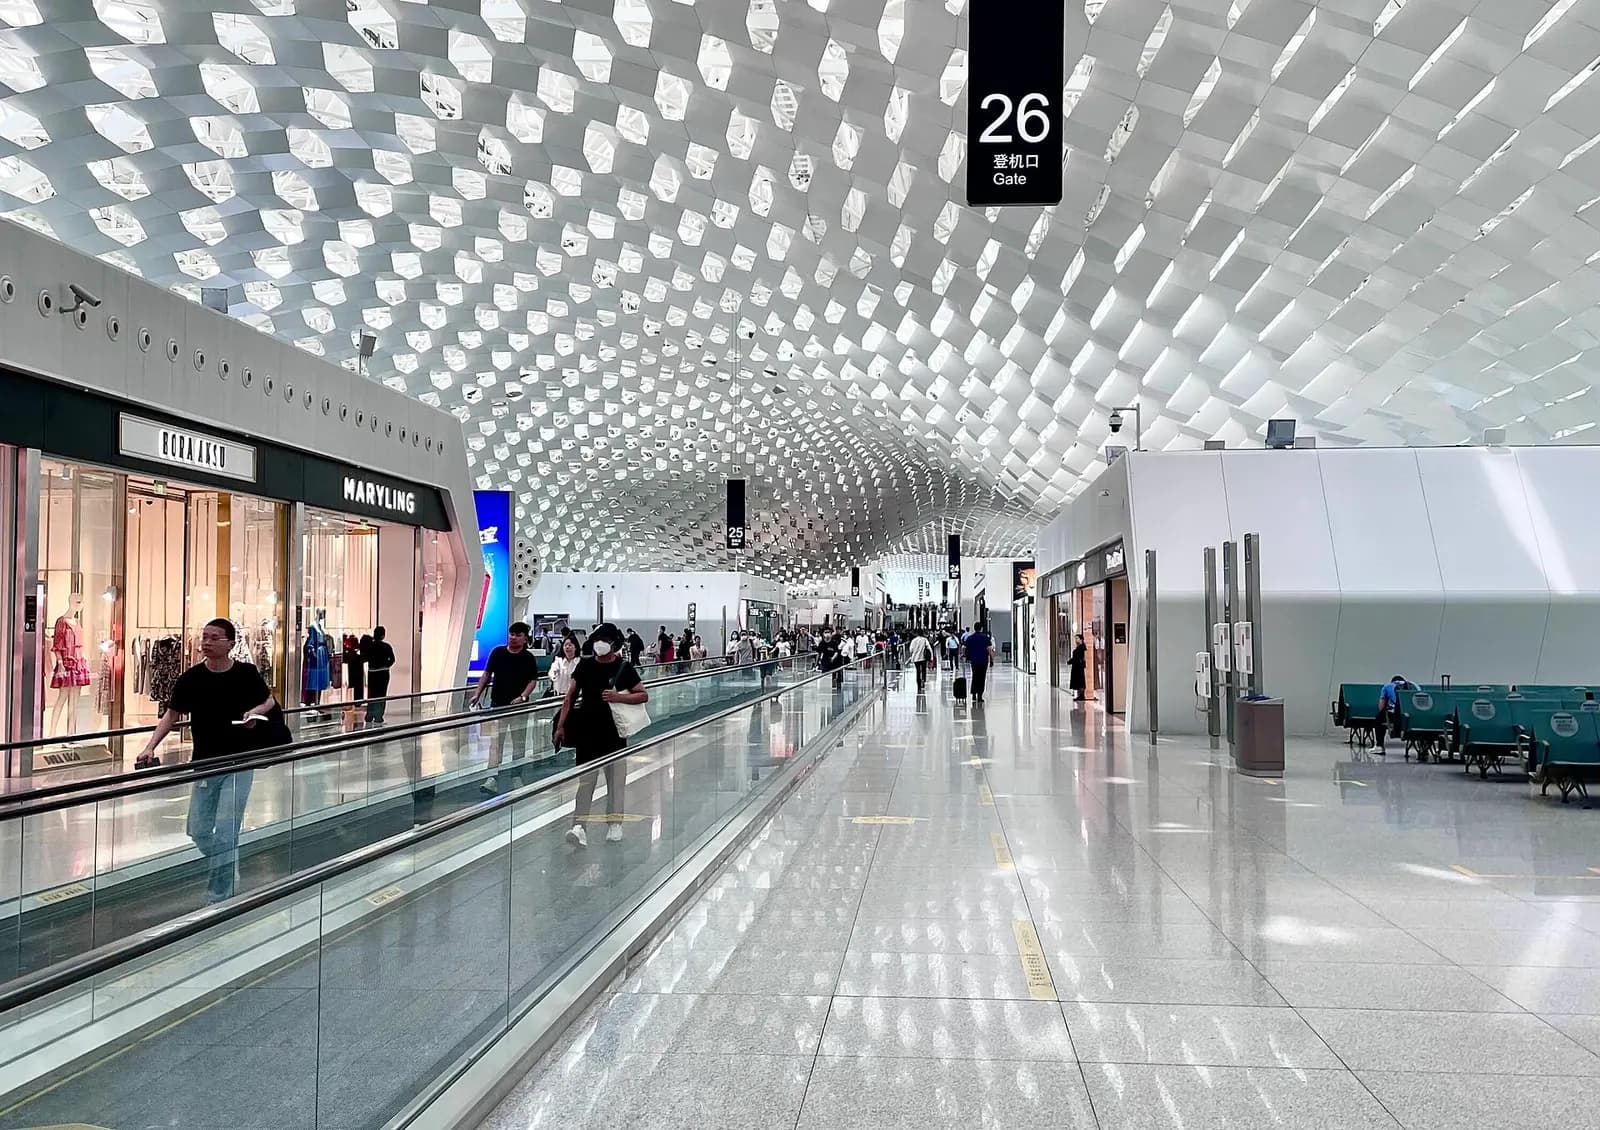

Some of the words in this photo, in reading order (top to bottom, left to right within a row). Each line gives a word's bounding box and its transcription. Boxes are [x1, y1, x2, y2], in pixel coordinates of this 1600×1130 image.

[979, 92, 1050, 143] 26
[993, 153, 1039, 169] 登机口
[992, 172, 1027, 186] Gate
[162, 431, 194, 461] BORA
[197, 439, 226, 468] AKSU
[343, 476, 415, 515] MARYLING
[728, 527, 744, 538] 25
